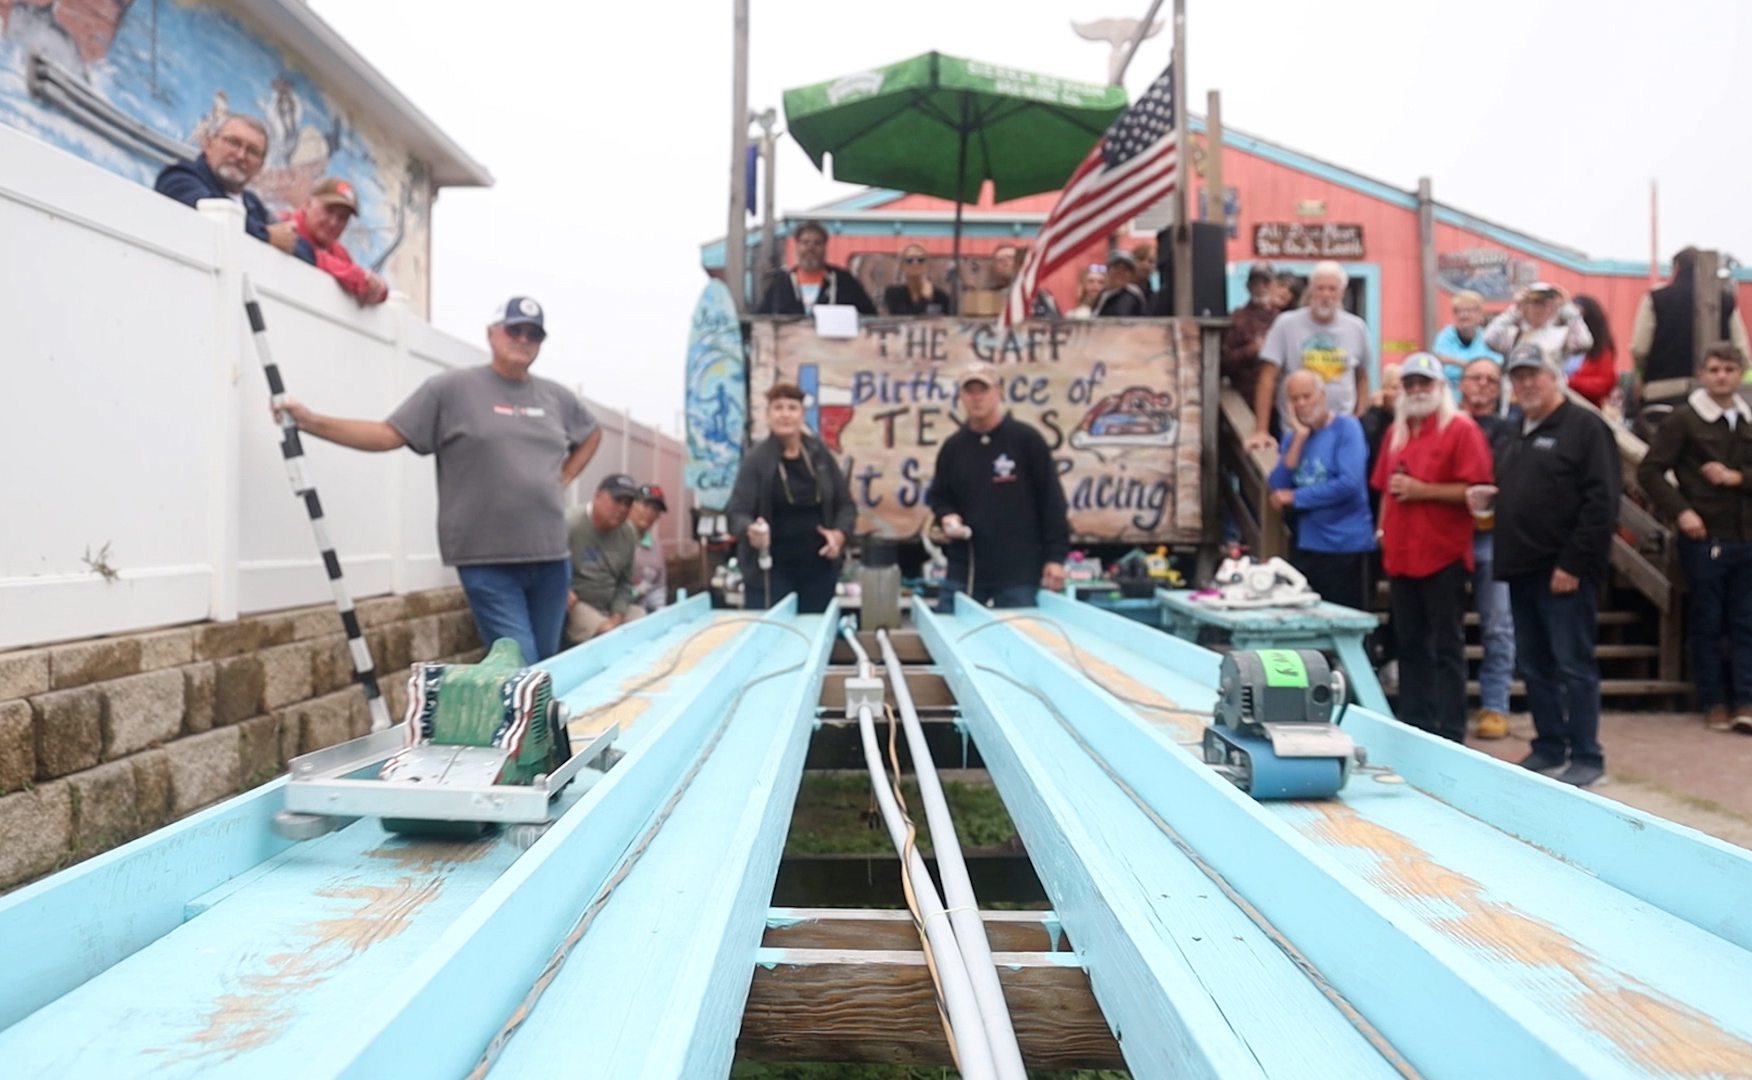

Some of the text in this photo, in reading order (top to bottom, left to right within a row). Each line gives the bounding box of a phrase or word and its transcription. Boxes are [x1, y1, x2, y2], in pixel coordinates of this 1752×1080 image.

[866, 326, 949, 362] THE
[852, 361, 1106, 408] Birthce of
[873, 407, 1064, 451] TES
